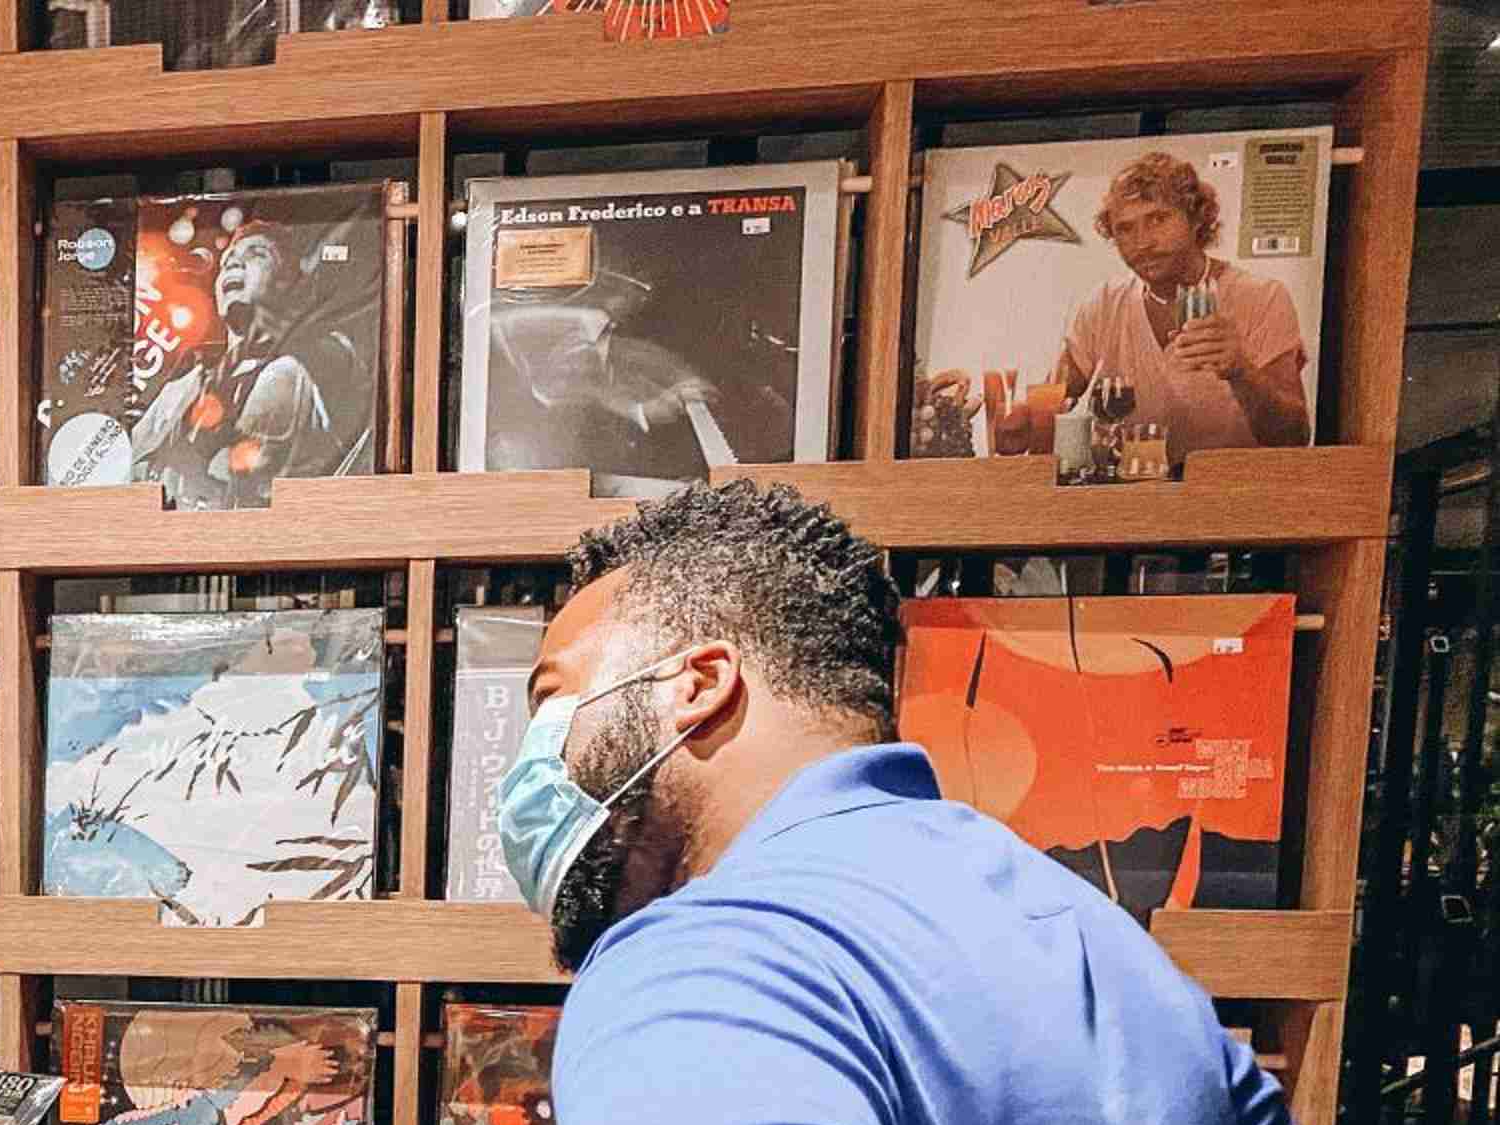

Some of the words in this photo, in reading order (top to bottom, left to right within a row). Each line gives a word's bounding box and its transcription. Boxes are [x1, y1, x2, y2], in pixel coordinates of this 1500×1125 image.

[500, 207, 563, 225] Edson
[567, 200, 664, 221] Frederico
[670, 203, 684, 217] e
[687, 201, 703, 216] a
[707, 194, 797, 215] TRANSA
